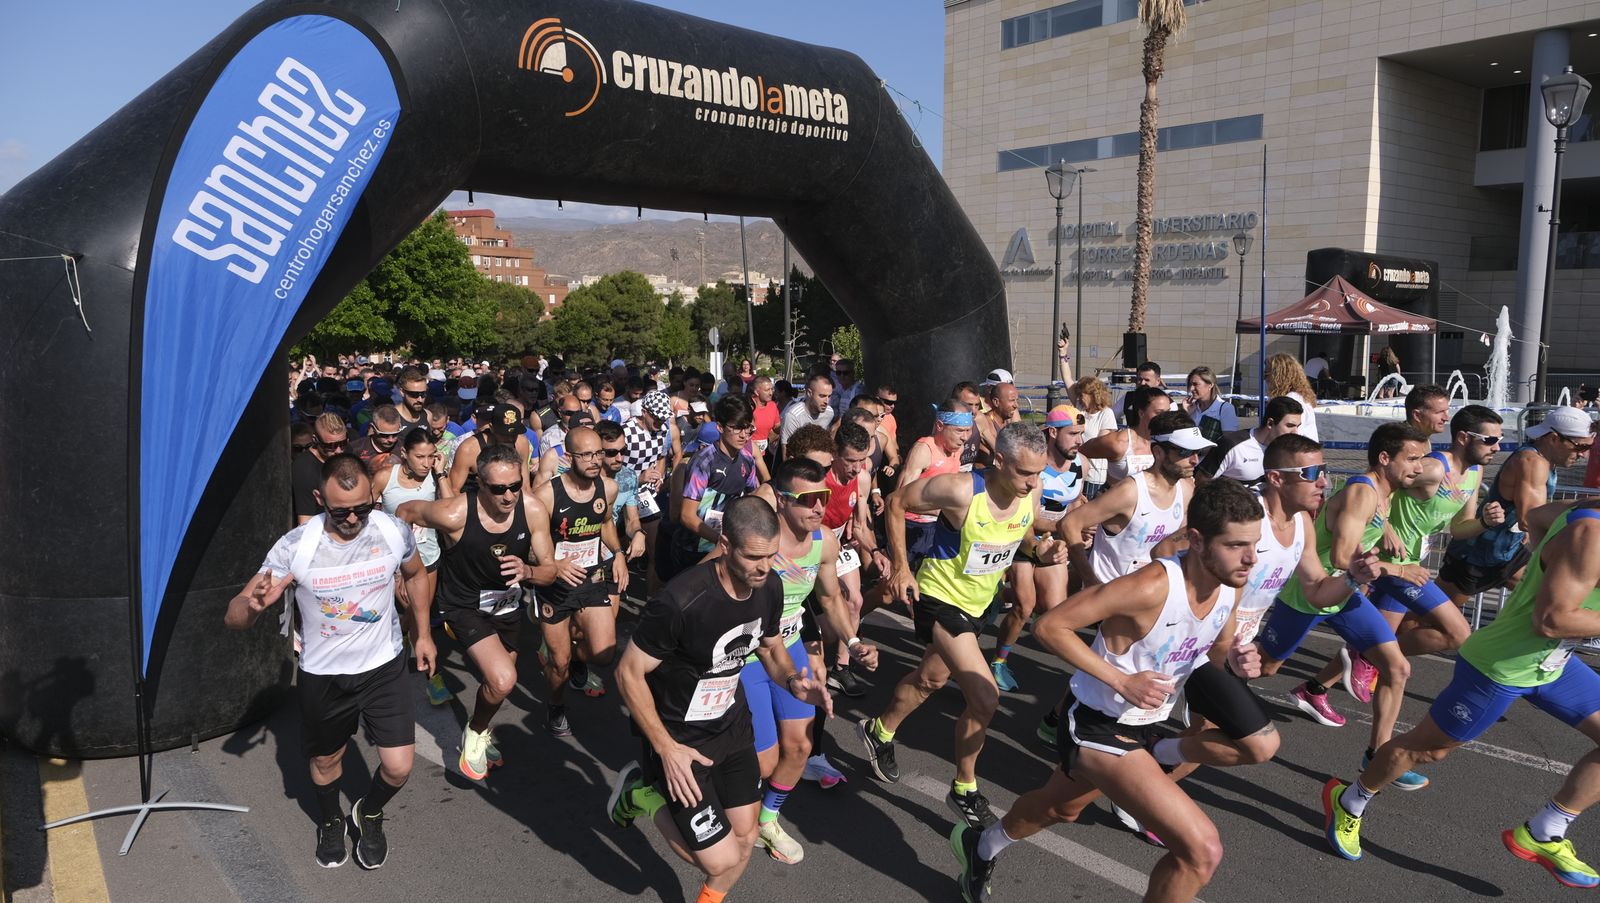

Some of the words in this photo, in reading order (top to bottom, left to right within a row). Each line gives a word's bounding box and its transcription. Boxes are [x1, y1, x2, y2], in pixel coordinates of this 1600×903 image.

[611, 50, 849, 126] cruzandolameta
[695, 107, 788, 134] cronometraje
[790, 120, 849, 142] deportivo
[274, 118, 392, 300] centrohogarsanchez.es
[1150, 210, 1259, 235] IVERSITARIO
[1077, 241, 1229, 264] TORRERDENAS
[574, 516, 588, 527] GO
[1154, 524, 1166, 535] GO
[981, 549, 1011, 565] 109
[1271, 566, 1284, 579] GO
[1179, 636, 1199, 651] GO
